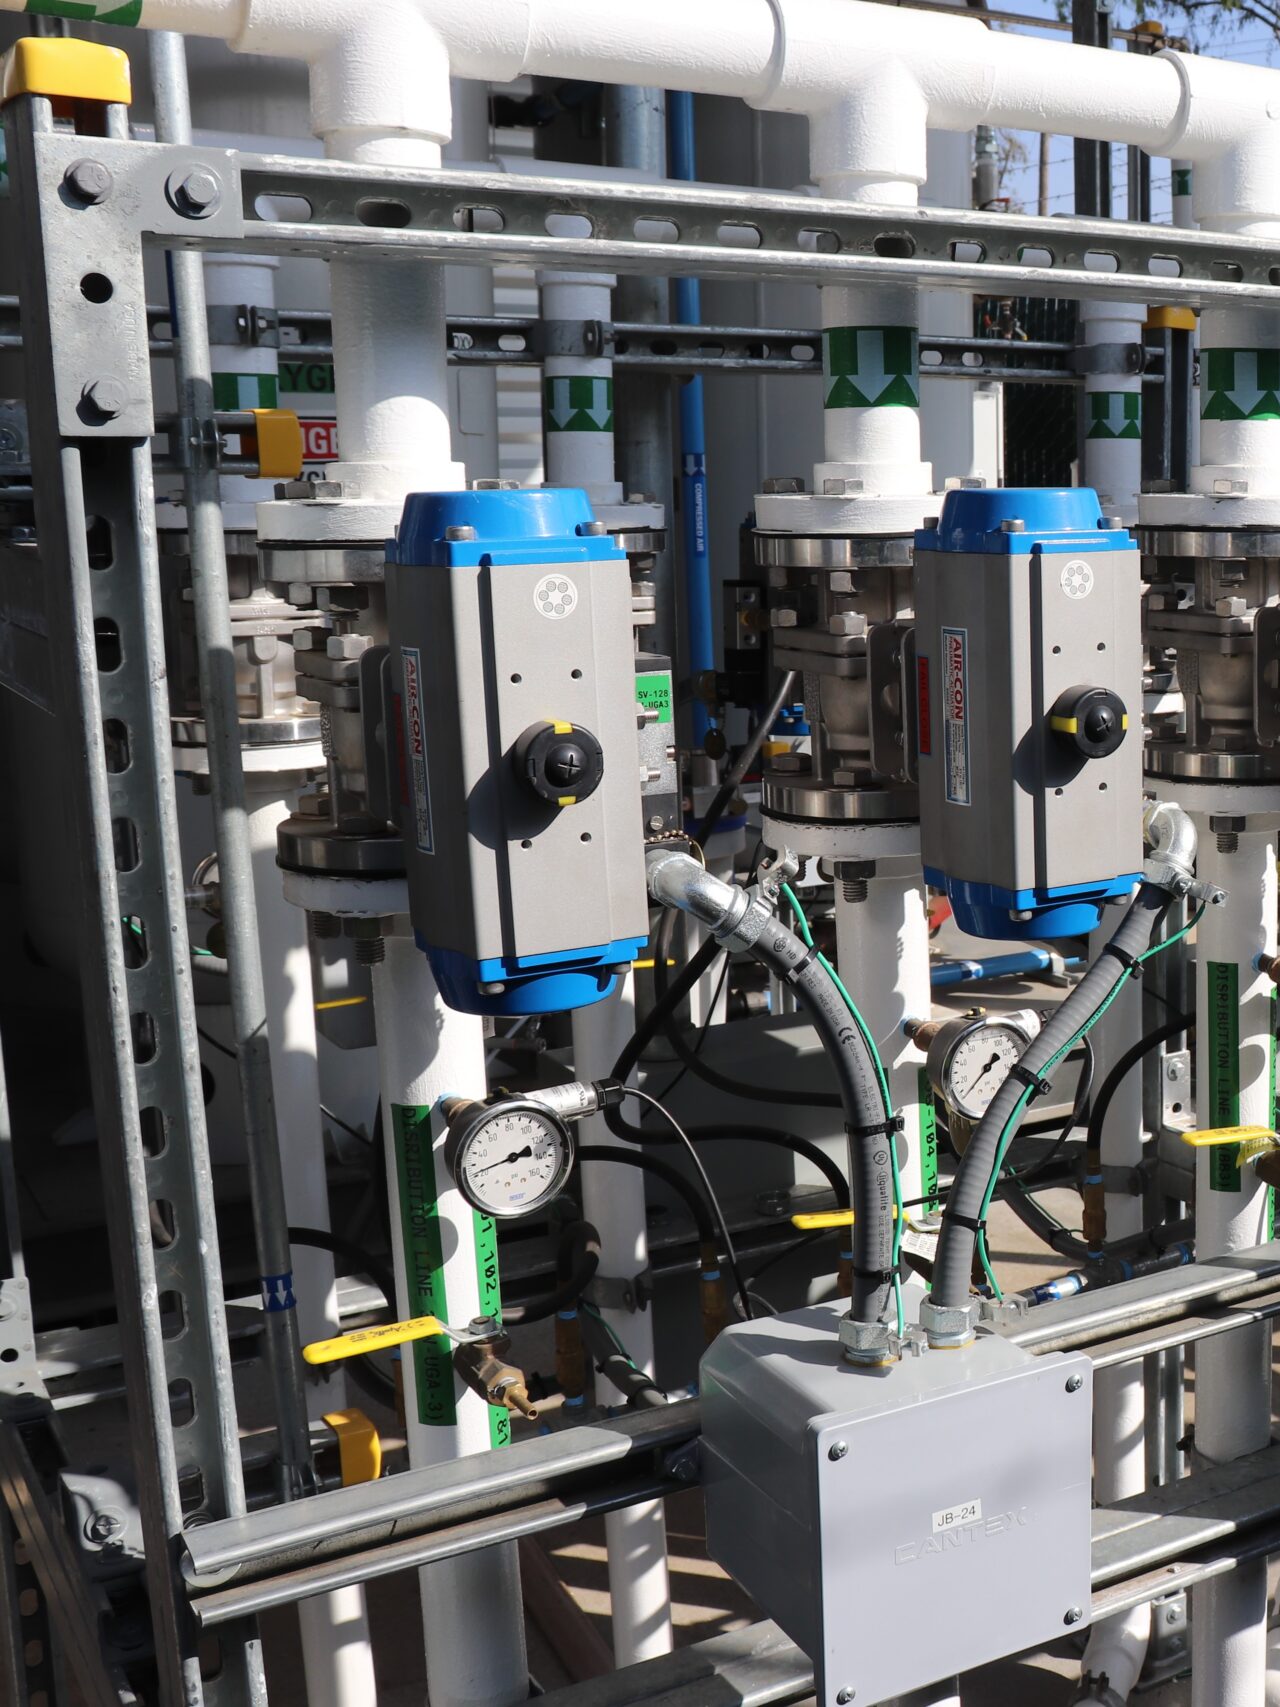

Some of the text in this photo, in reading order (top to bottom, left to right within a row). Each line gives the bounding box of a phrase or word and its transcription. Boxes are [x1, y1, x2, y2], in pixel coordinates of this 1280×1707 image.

[695, 483, 704, 552] COMPRESSED AIR
[951, 638, 965, 720] AIR-CON
[638, 690, 669, 699] SV-128
[407, 658, 421, 755] AIR-CON
[1216, 964, 1230, 1069] DISRIBUTION
[831, 1016, 840, 1027] USA
[993, 1039, 1003, 1047] 100
[968, 1045, 976, 1053] 60
[1001, 1048, 1012, 1056] 120
[959, 1058, 967, 1067] 40
[960, 1075, 968, 1083] 20
[1217, 1080, 1230, 1116] LINE
[505, 1122, 514, 1131] 80
[520, 1126, 532, 1135] 100
[488, 1133, 498, 1142] 60
[532, 1135, 544, 1145] 120
[478, 1149, 488, 1158] 40
[535, 1151, 548, 1161] 140
[402, 1107, 427, 1239] DISRIBUTION
[480, 1168, 489, 1177] 20
[529, 1168, 541, 1177] 160
[414, 1250, 433, 1298] LINE
[937, 1505, 976, 1527] JB-24
[895, 1506, 1028, 1565] CANTEX
